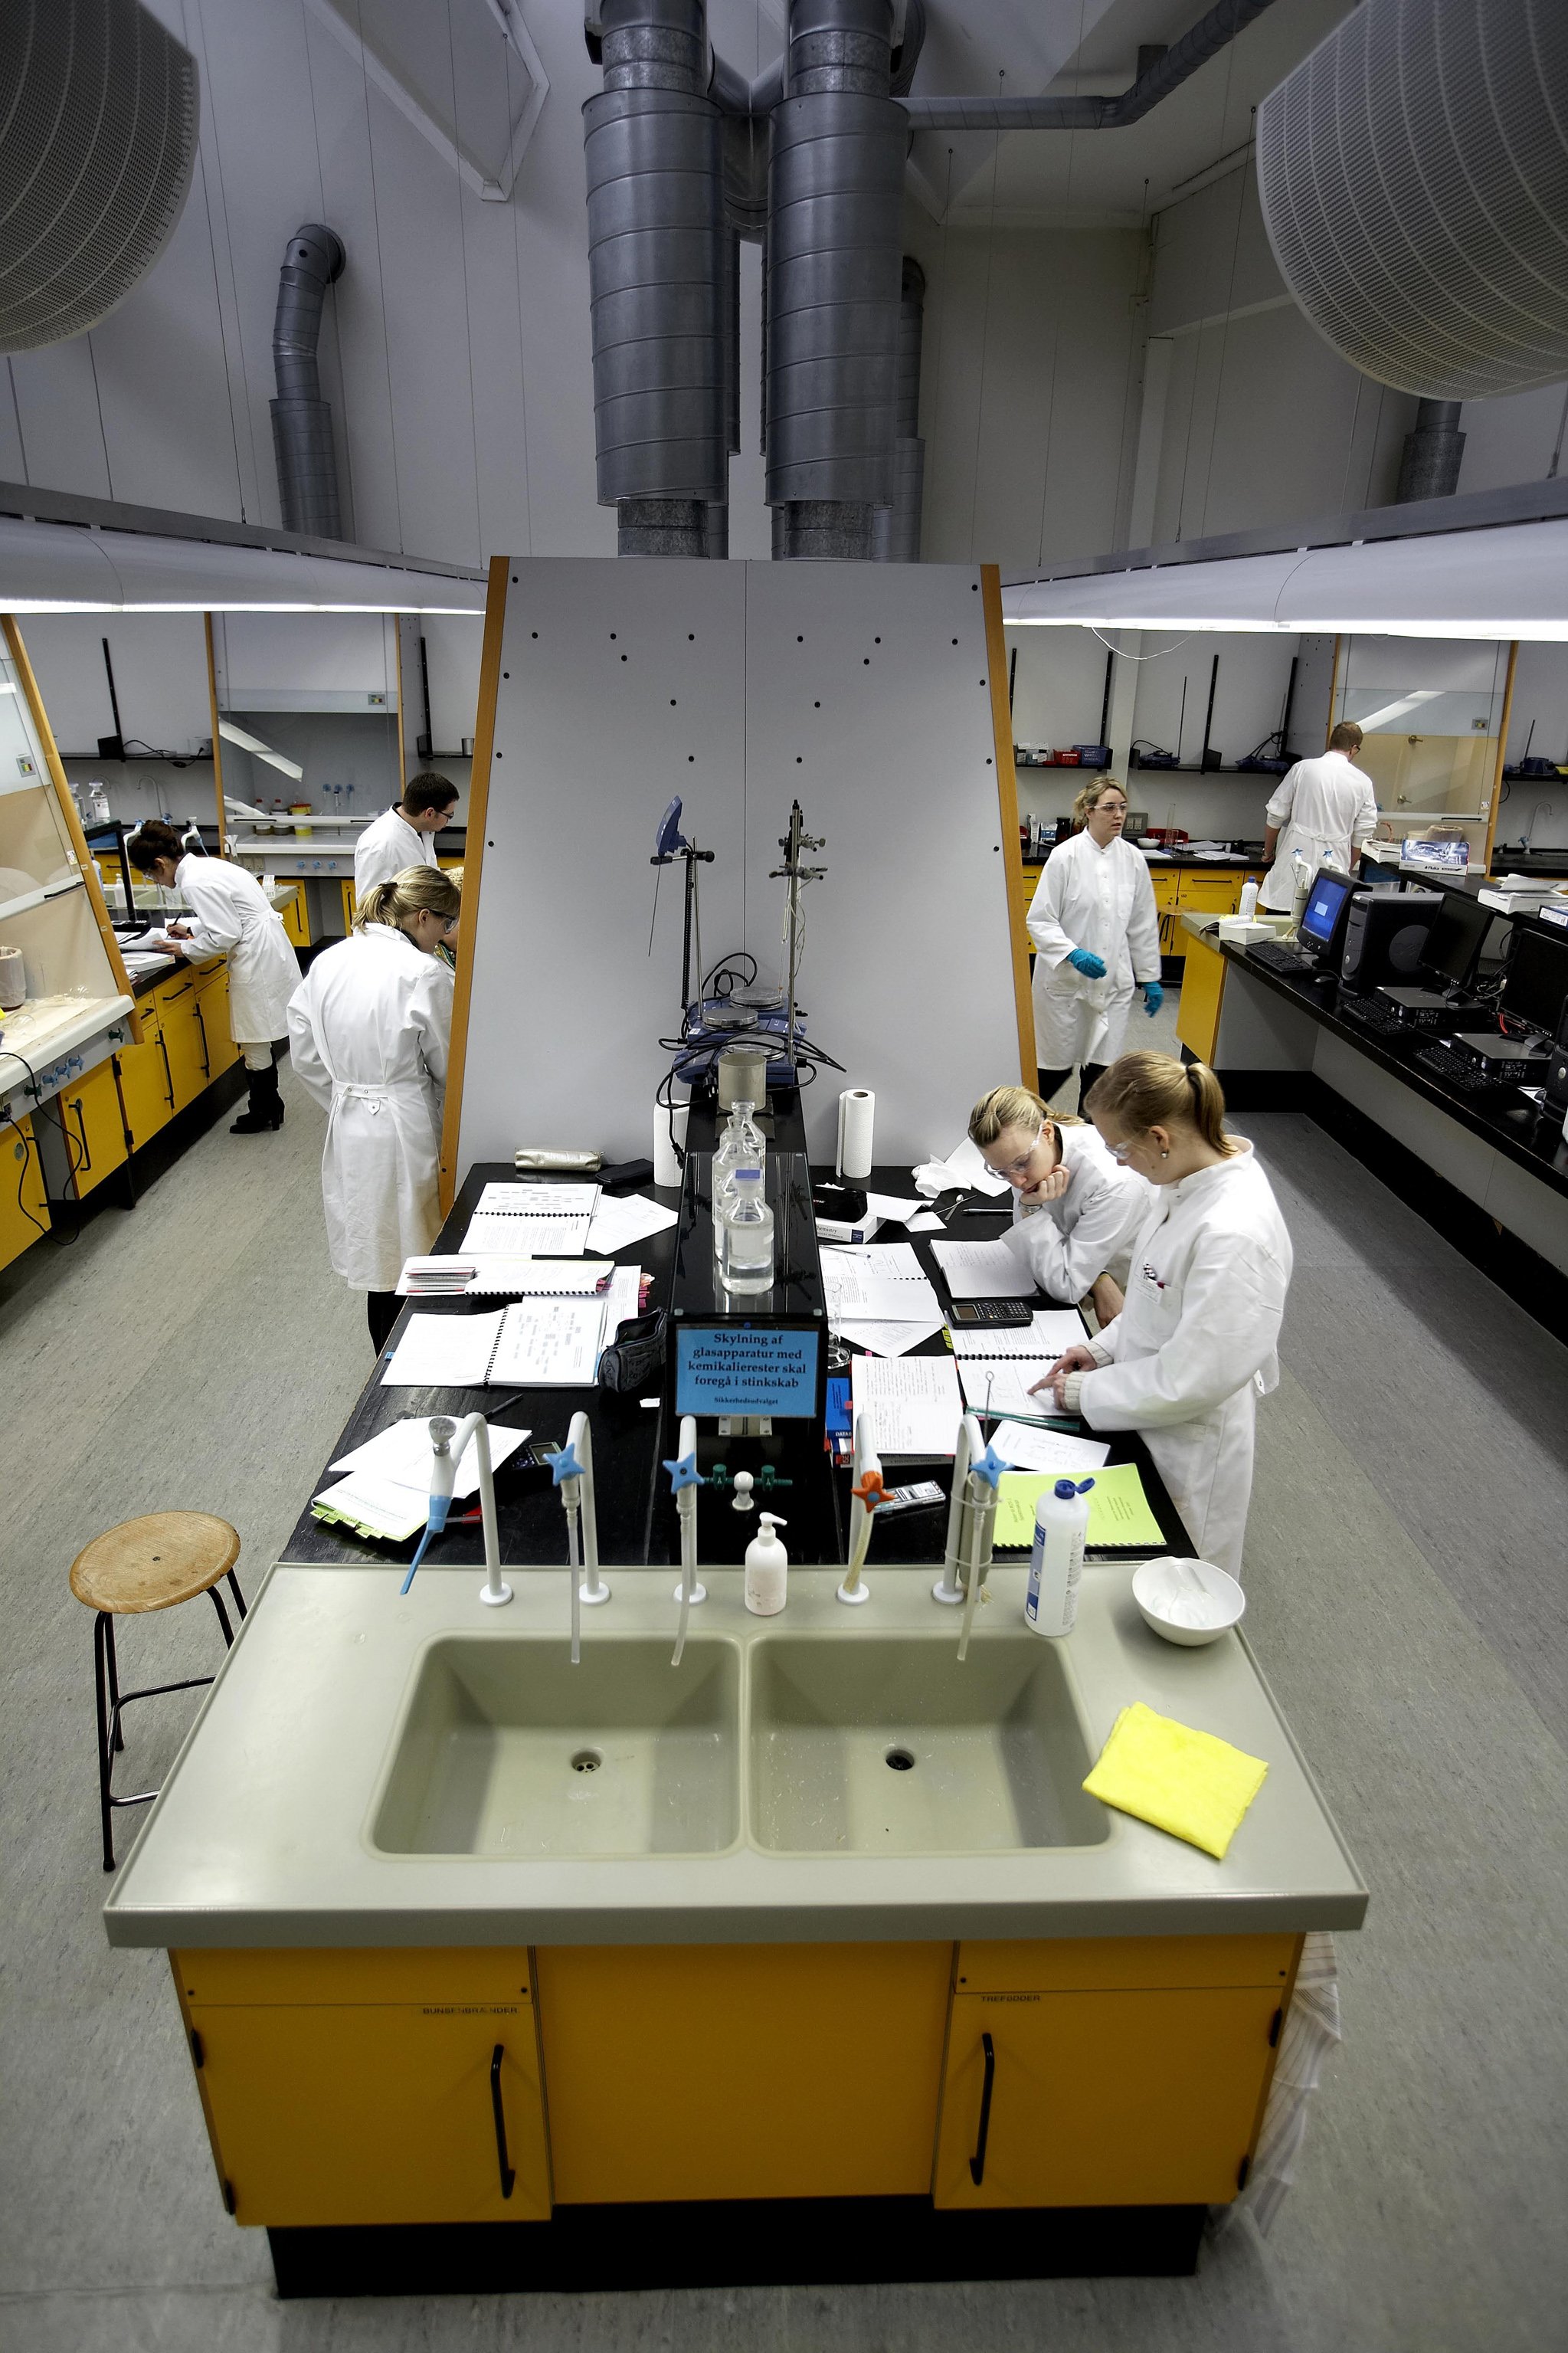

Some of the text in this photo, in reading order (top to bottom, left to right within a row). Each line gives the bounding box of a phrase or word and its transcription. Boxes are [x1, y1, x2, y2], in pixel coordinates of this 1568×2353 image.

[817, 1225, 836, 1234] hemistry
[714, 1333, 784, 1346] Skylning af
[692, 1347, 802, 1359] glasapparatur med
[688, 1361, 806, 1374] kemikalierester skal
[695, 1376, 799, 1388] foregå i stinkskab
